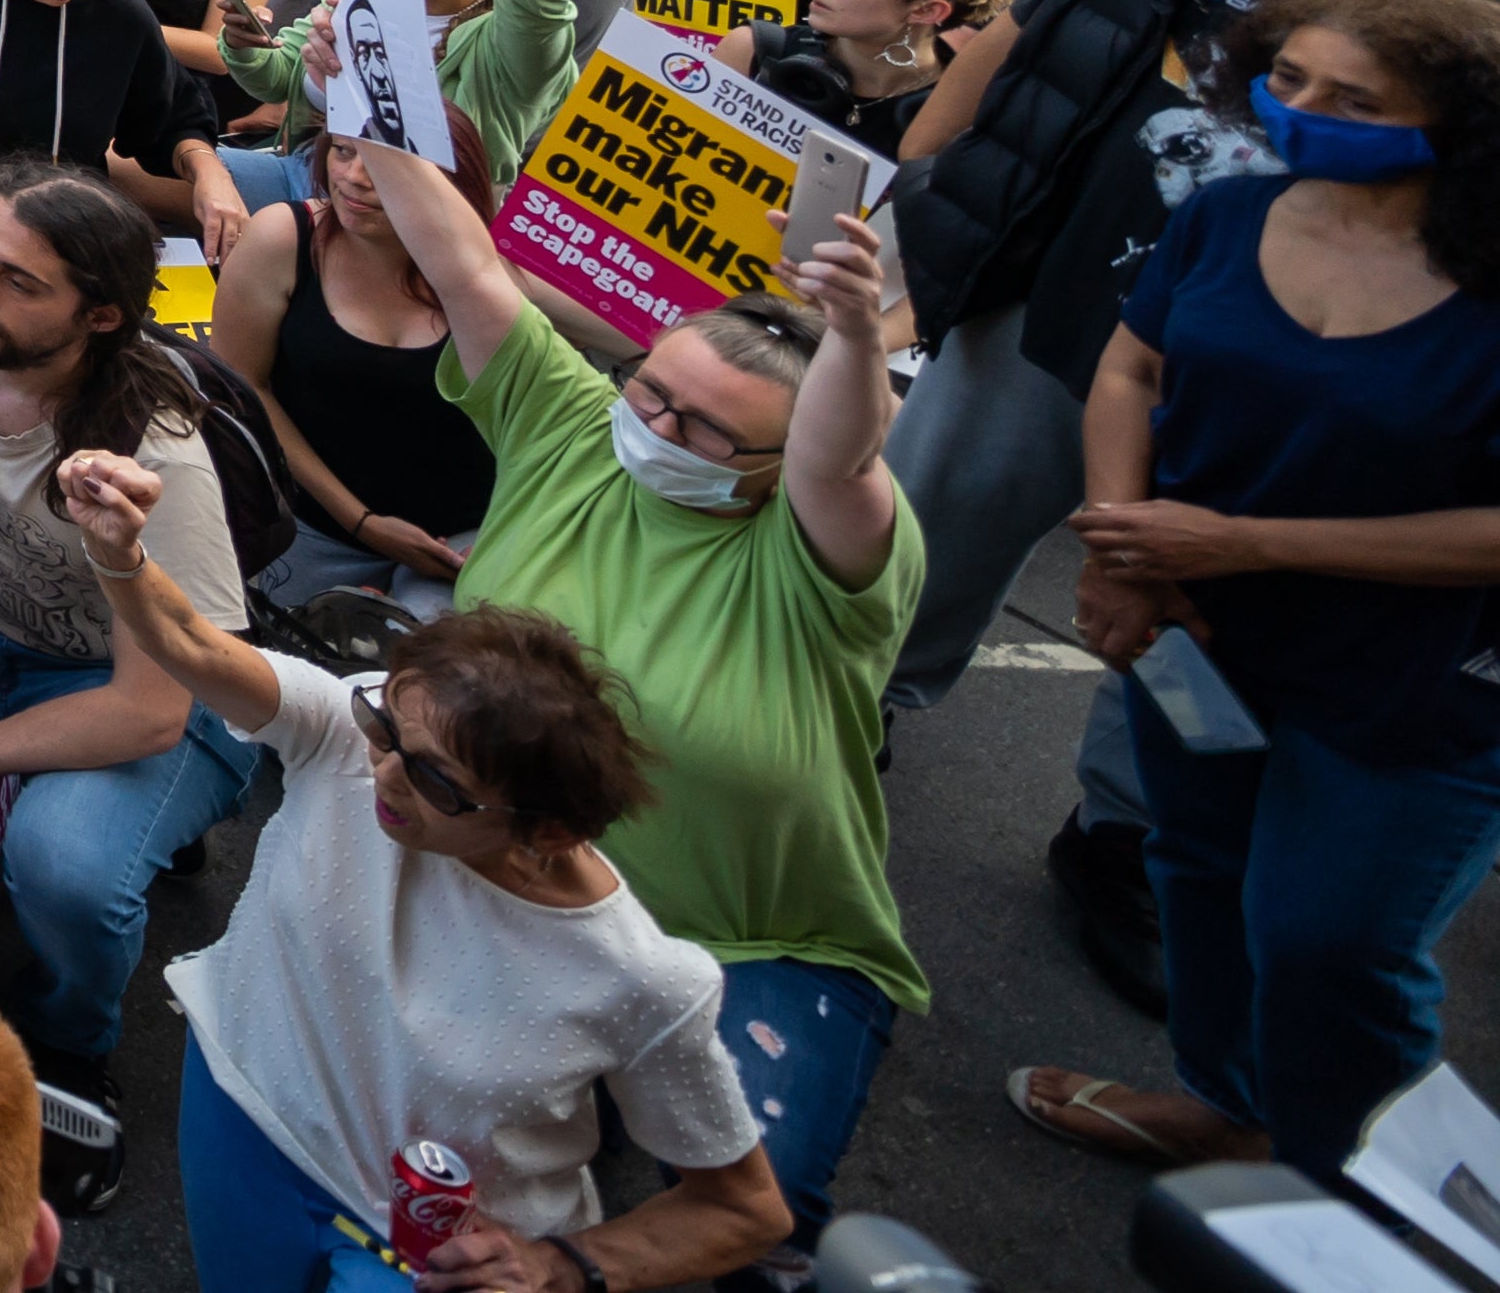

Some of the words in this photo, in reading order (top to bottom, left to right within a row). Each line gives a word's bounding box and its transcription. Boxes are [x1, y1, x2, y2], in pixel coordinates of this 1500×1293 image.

[563, 113, 716, 217] make
[588, 65, 794, 210] Migran
[523, 190, 596, 246] Stop
[600, 236, 655, 281] the
[546, 152, 641, 216] our
[644, 201, 774, 295] NHS
